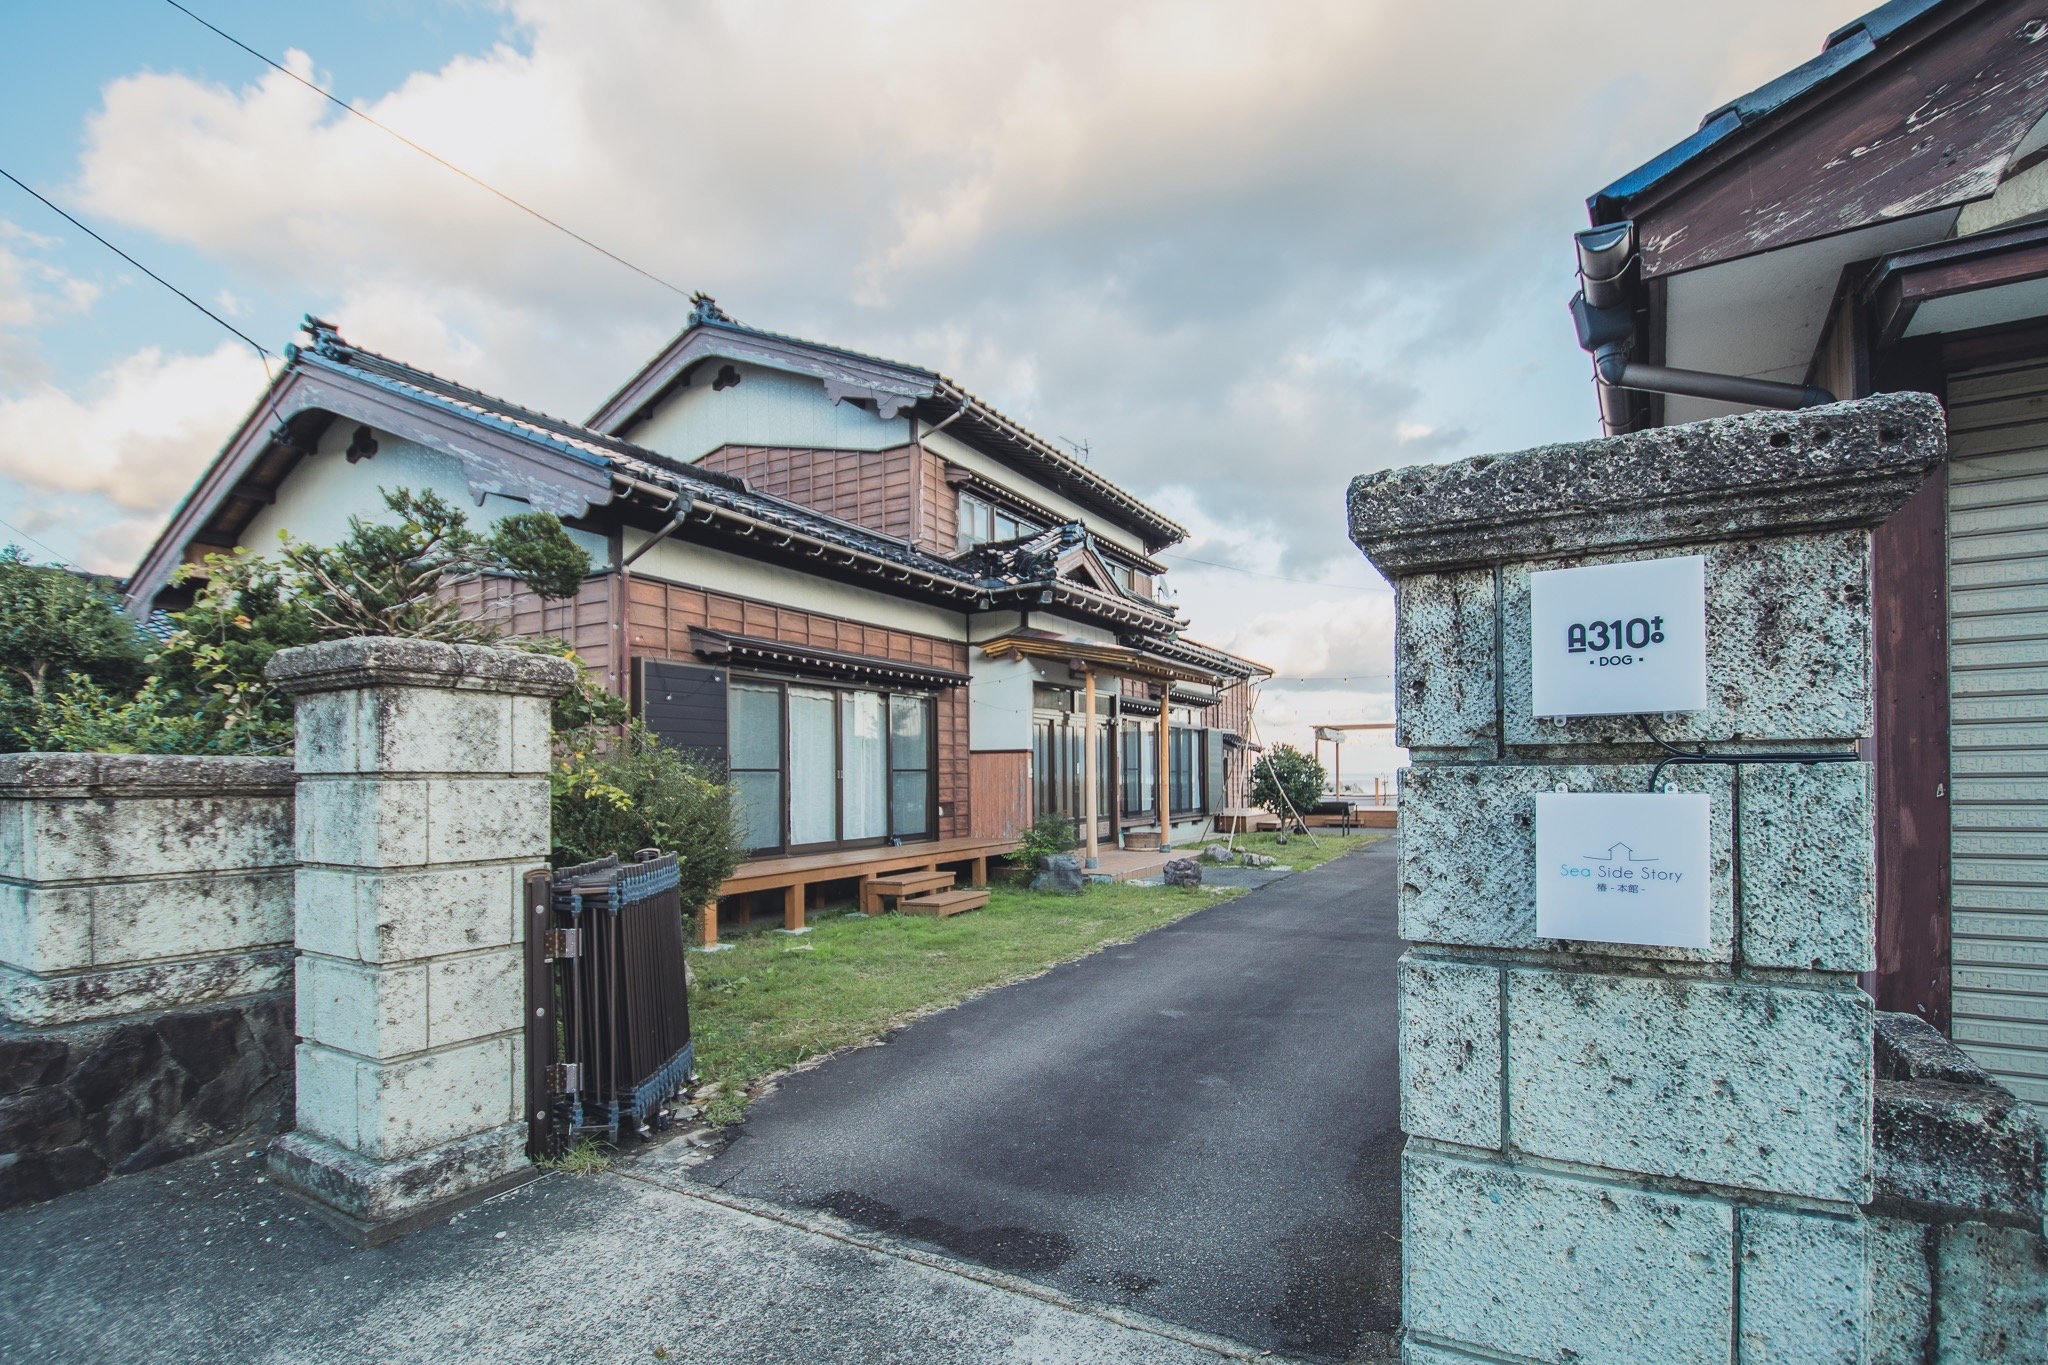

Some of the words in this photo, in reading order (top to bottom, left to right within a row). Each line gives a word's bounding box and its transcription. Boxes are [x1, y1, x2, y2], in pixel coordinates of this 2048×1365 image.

[1599, 654, 1633, 667] DOG
[1560, 863, 1591, 877] Sea
[1597, 865, 1634, 880] Side
[1640, 867, 1683, 883] Story
